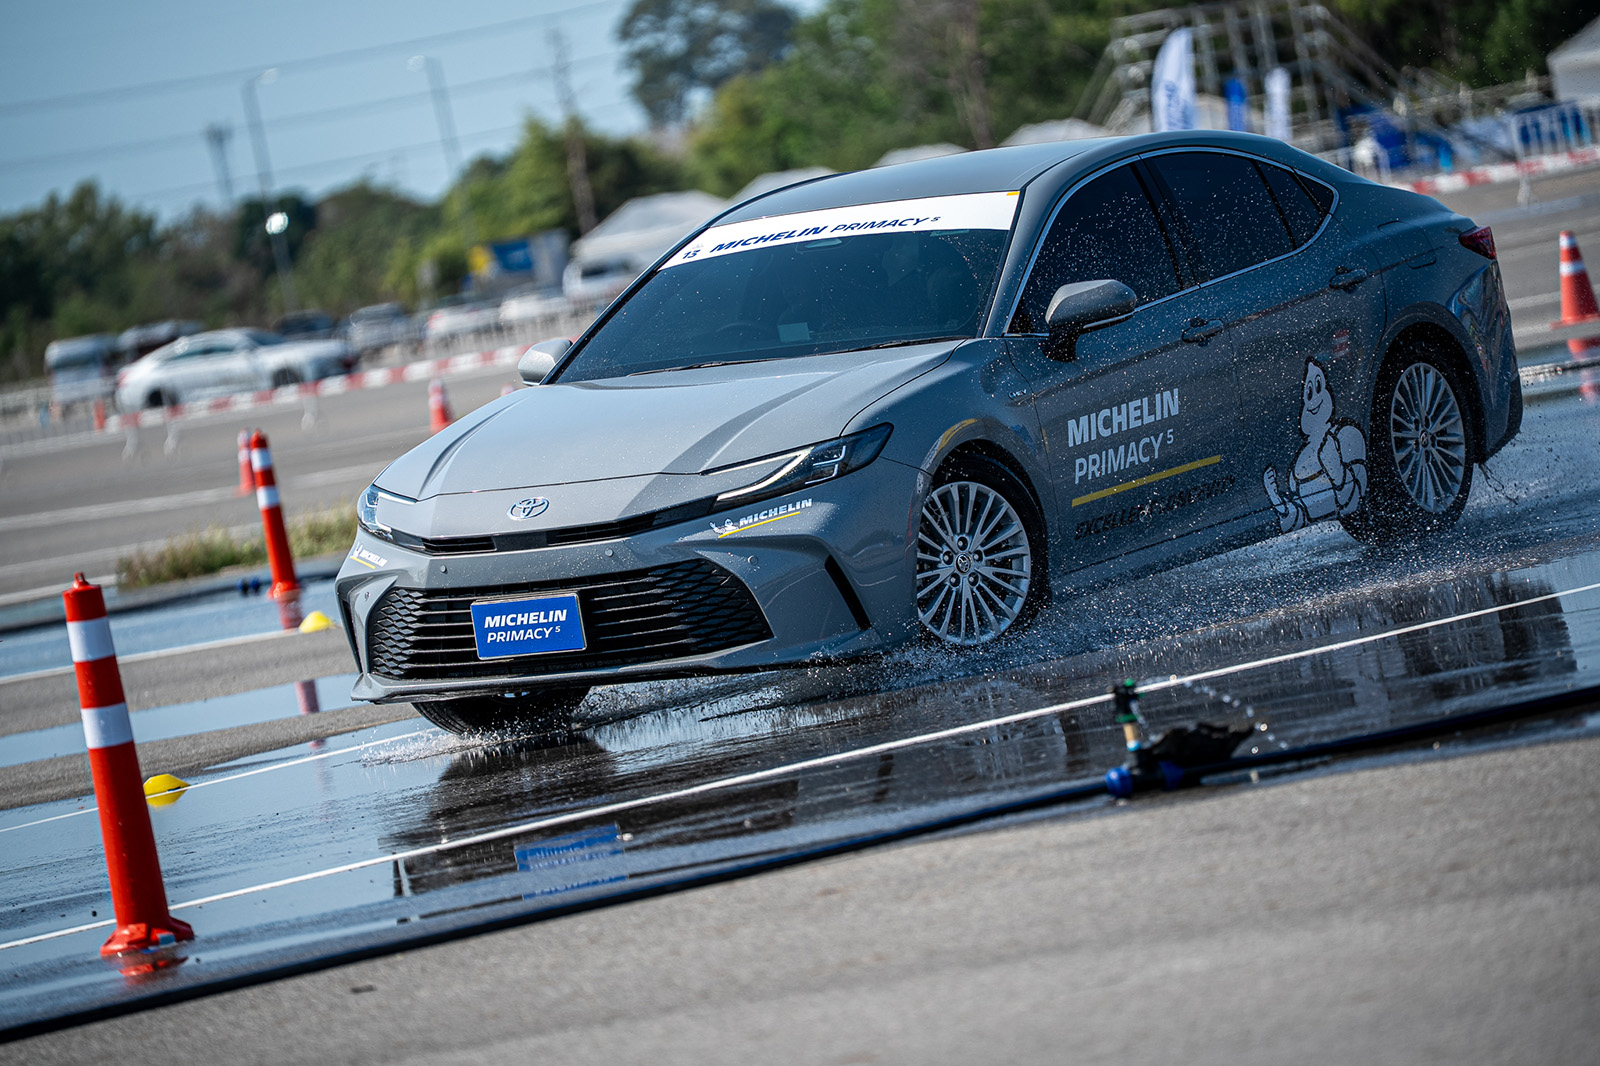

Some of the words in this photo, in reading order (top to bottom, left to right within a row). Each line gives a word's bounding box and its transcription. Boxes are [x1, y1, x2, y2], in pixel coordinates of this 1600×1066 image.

[709, 225, 829, 253] MICHELIN
[830, 217, 930, 233] PRIMACY
[1067, 387, 1180, 448] MICHELIN
[1074, 432, 1165, 485] PRIMACY
[739, 498, 813, 527] MICHELIN
[483, 608, 568, 629] MICHELIN
[486, 626, 554, 644] PRIMACY
